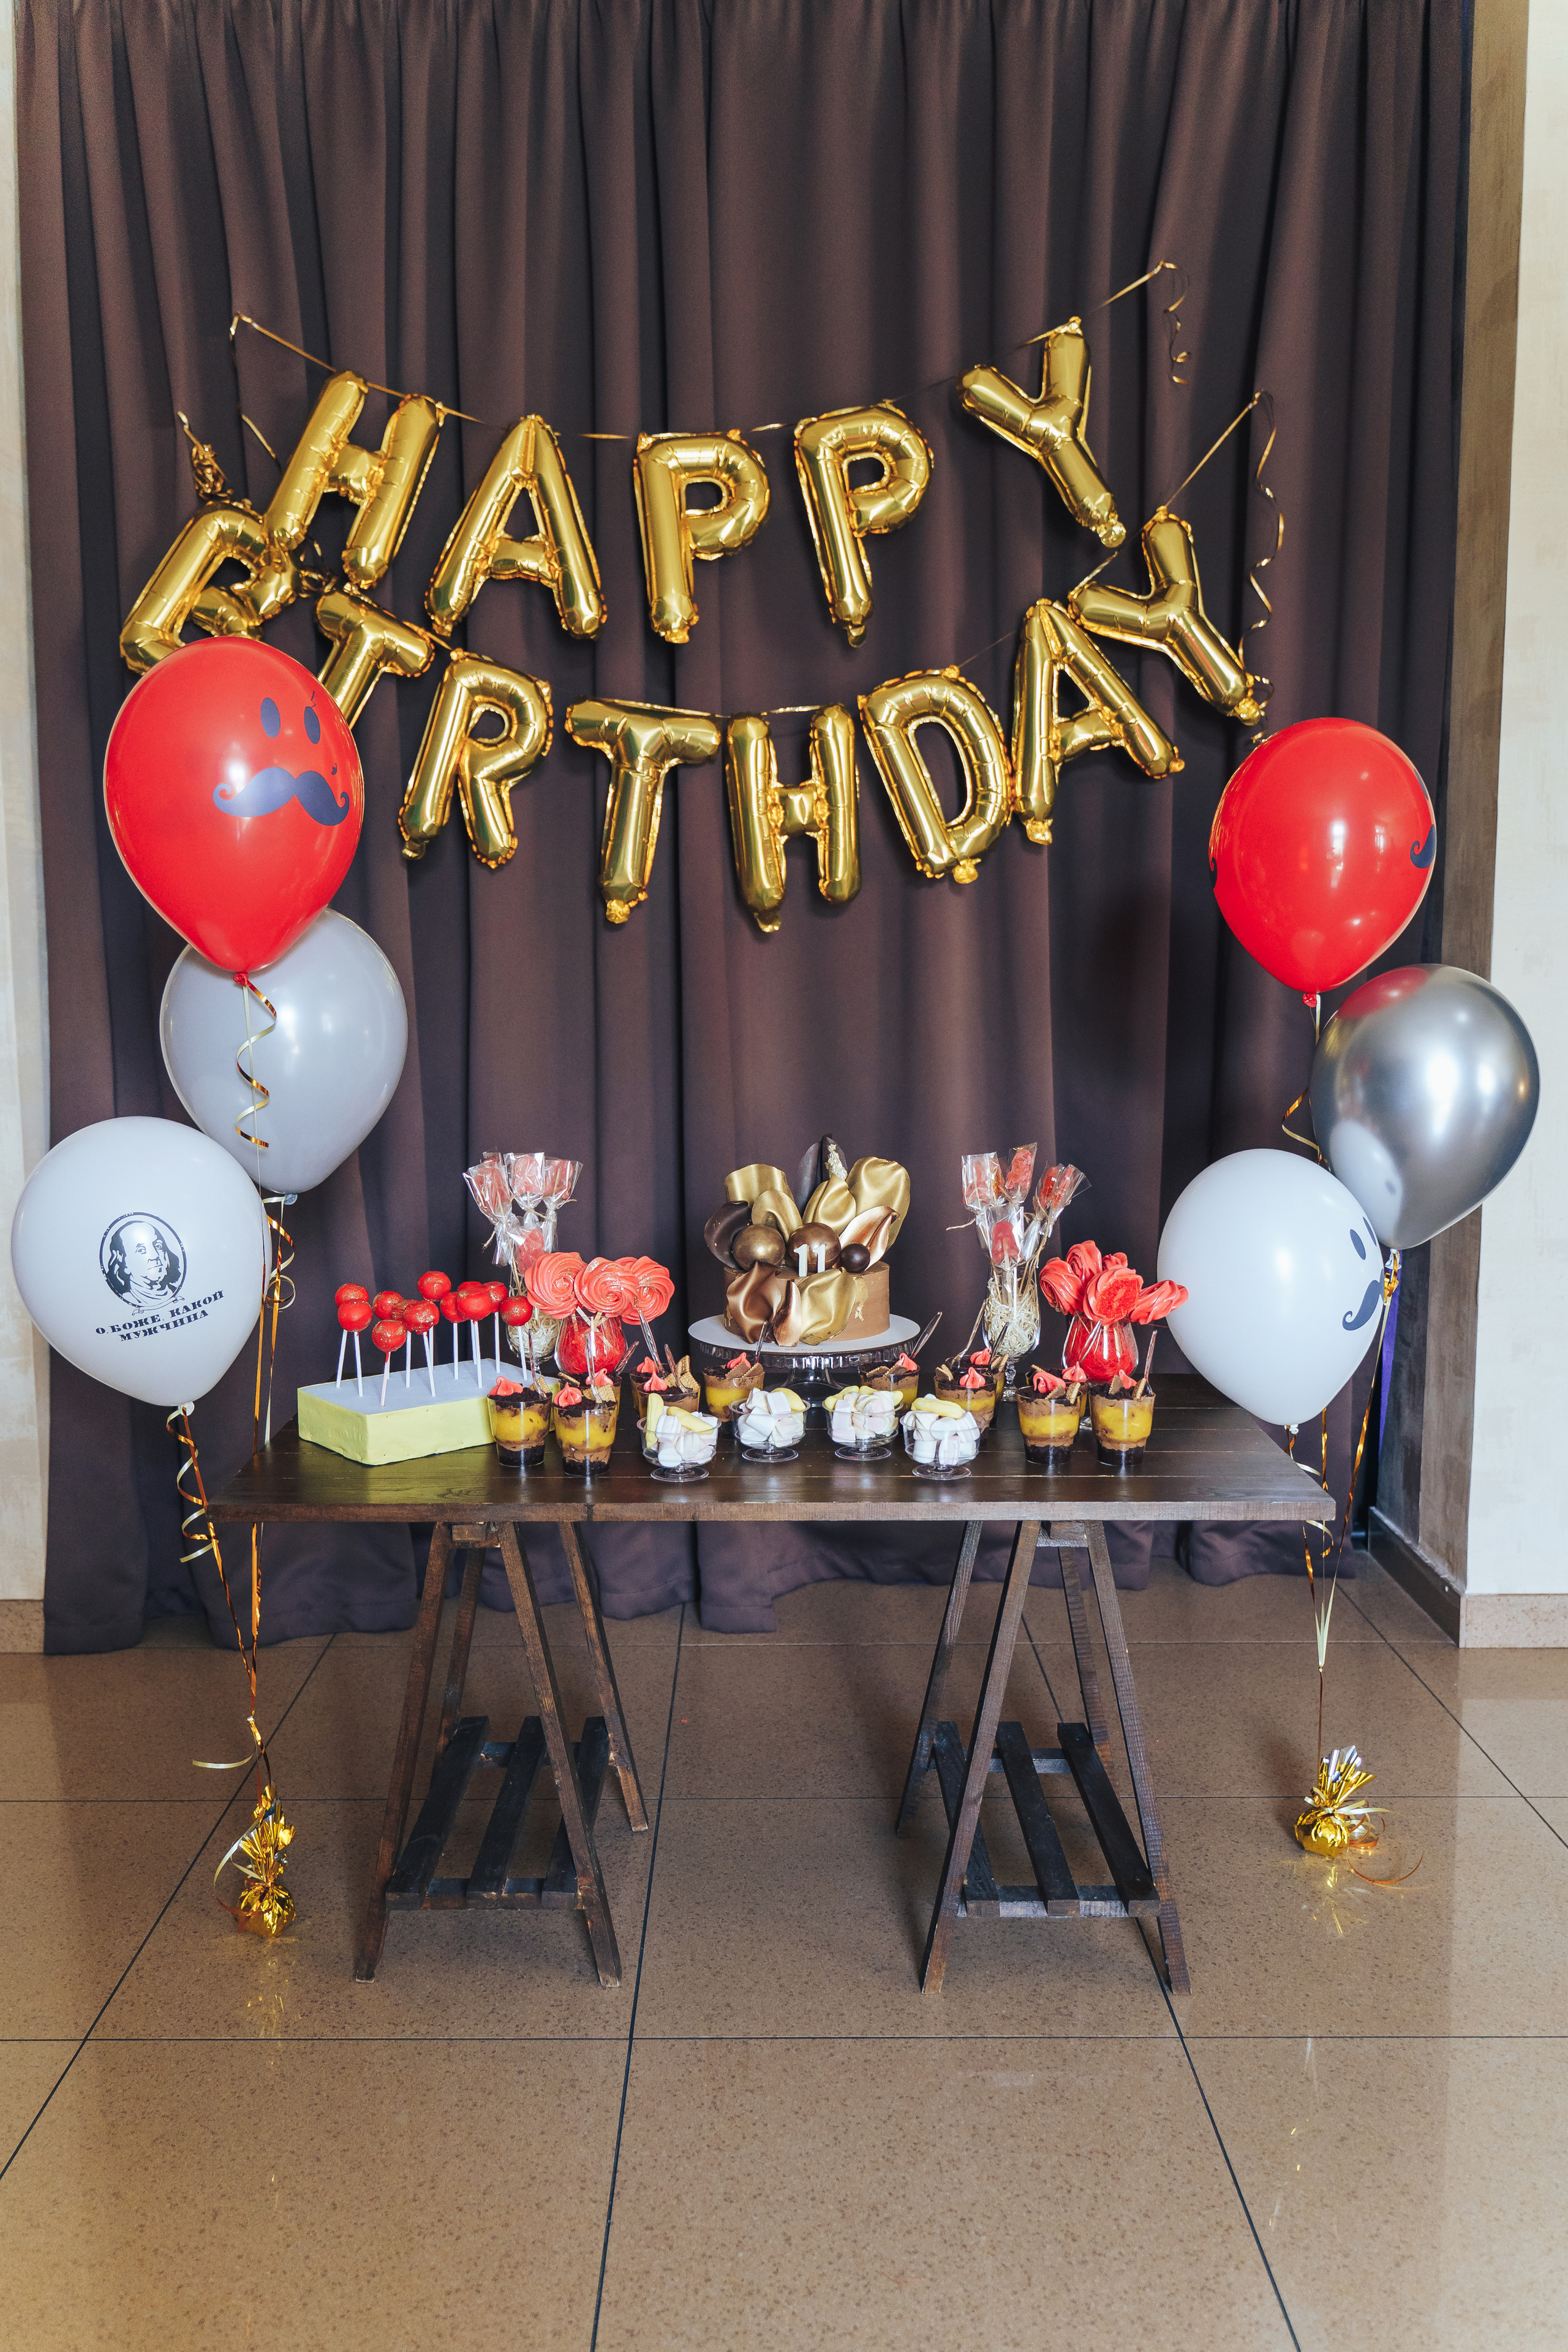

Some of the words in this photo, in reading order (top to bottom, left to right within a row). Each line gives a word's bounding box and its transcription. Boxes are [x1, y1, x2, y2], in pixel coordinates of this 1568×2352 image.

[266, 318, 1126, 647] HAPPY
[793, 1243, 826, 1277] 11
[168, 1289, 224, 1318] КАКОЙ
[119, 1310, 209, 1341] МУЖЧИНА
